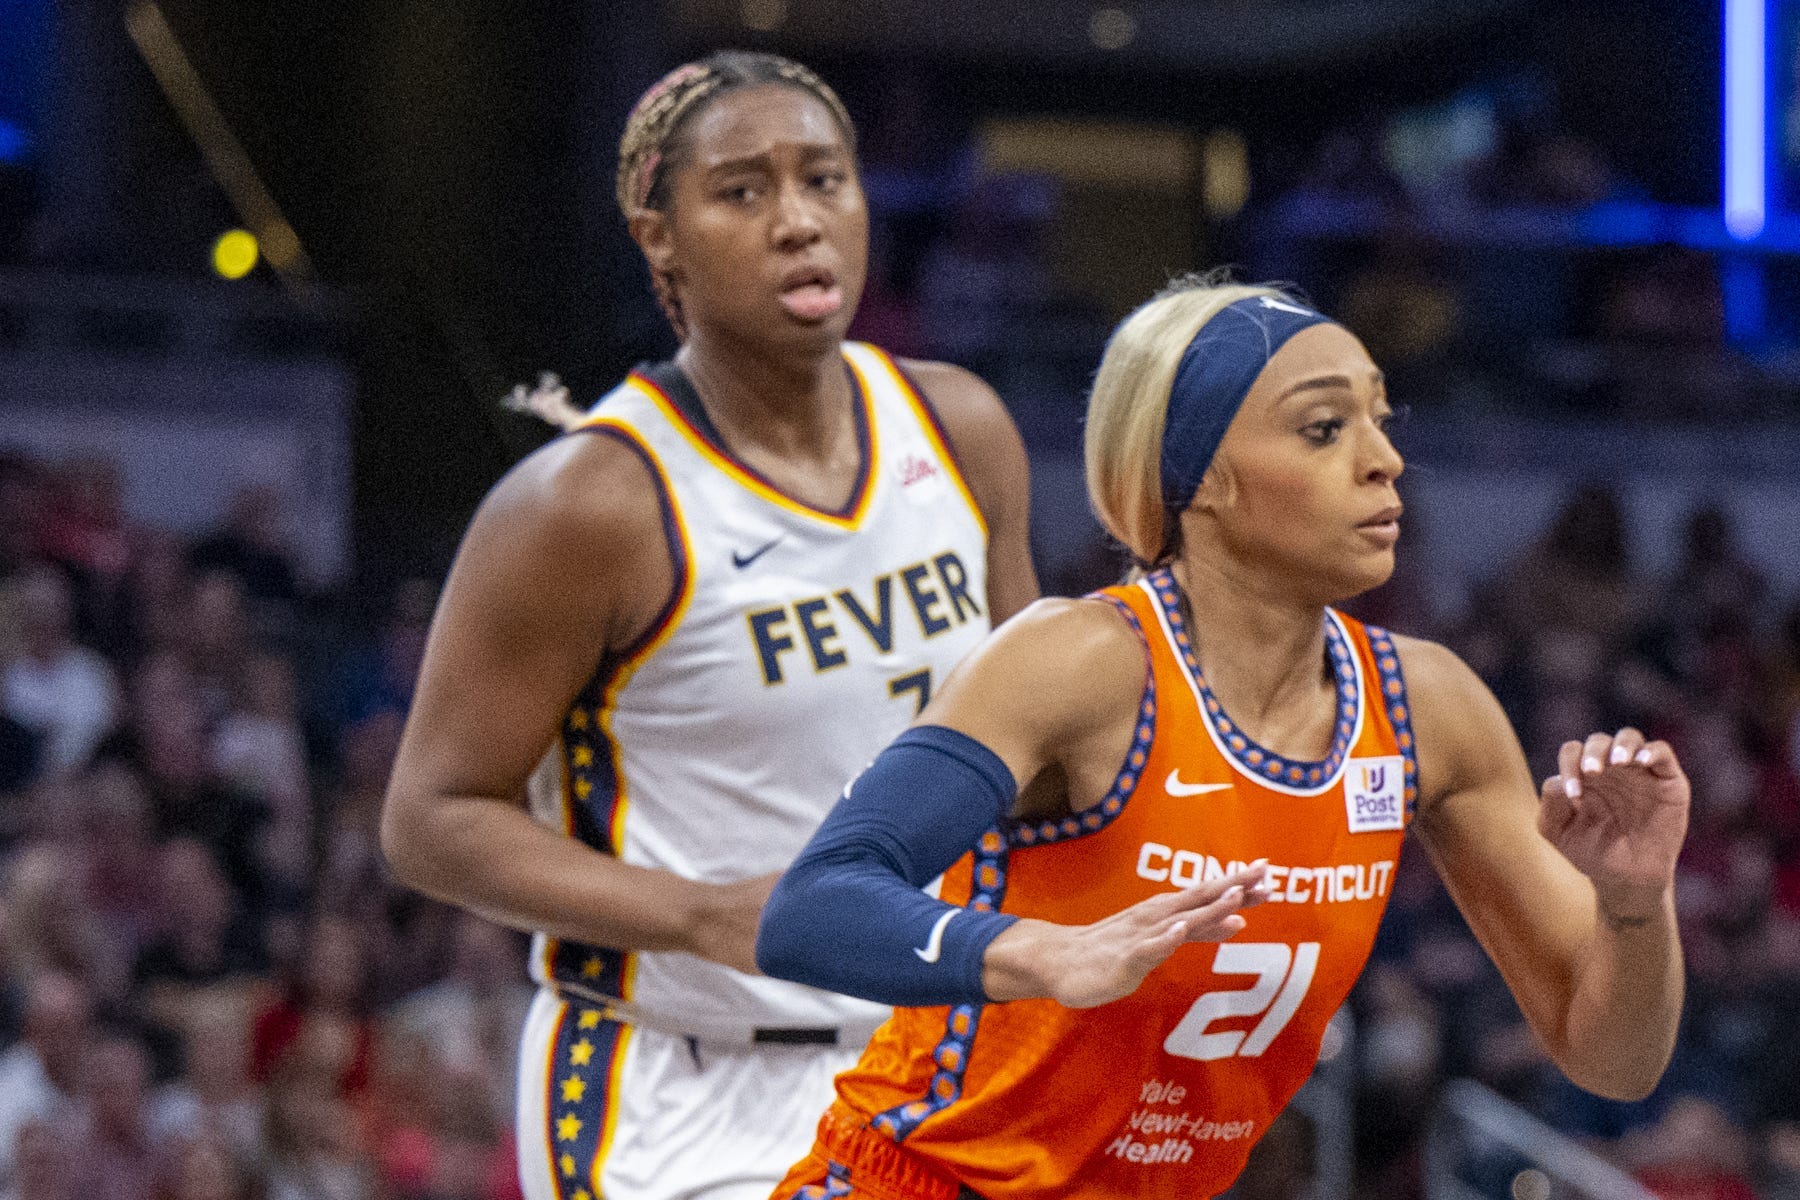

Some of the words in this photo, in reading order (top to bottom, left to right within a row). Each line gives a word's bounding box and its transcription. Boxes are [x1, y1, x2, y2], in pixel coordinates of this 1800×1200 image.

[746, 550, 982, 687] FEVER
[1355, 794, 1396, 814] Post
[1163, 941, 1322, 1061] 21
[1138, 1078, 1188, 1105] Yale
[1105, 1133, 1195, 1164] Health
